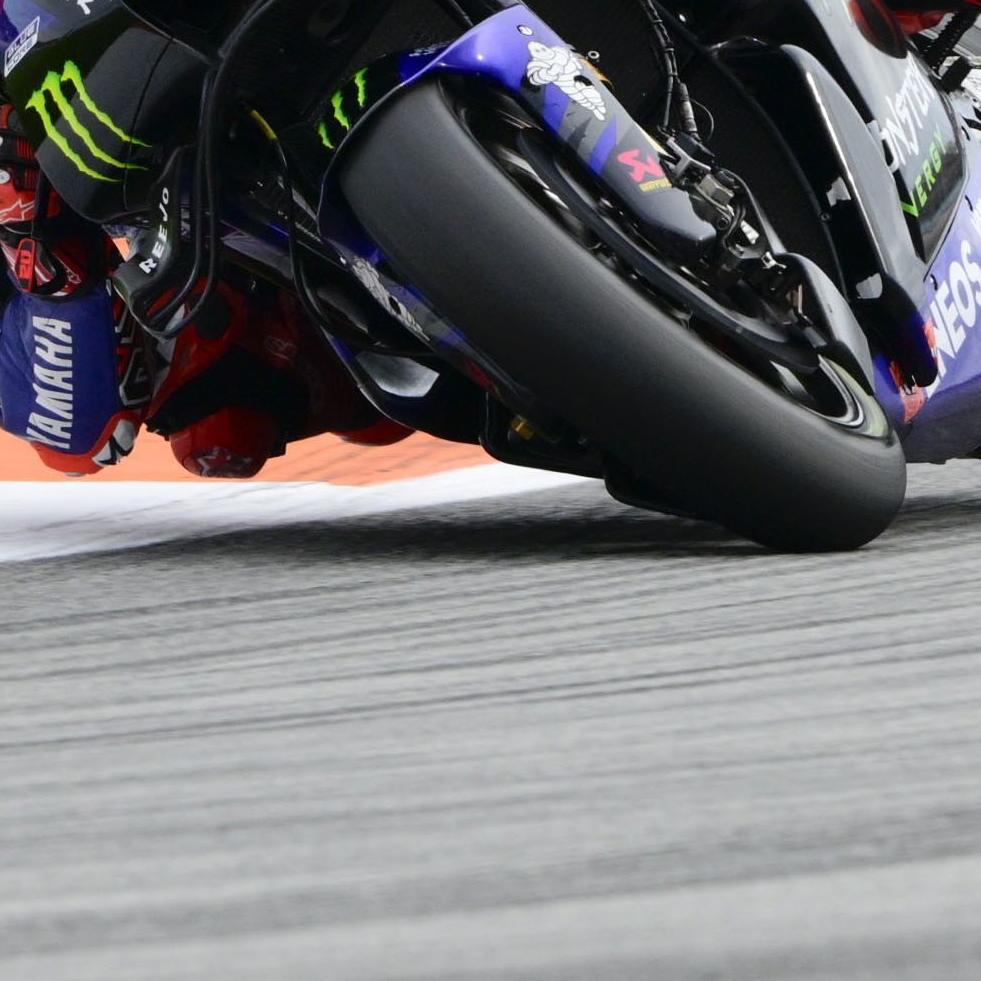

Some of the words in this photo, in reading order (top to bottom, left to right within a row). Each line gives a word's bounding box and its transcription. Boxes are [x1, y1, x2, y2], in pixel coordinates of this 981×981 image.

[901, 123, 947, 217] NERGY
[139, 187, 170, 274] REEVO
[27, 315, 73, 449] YAMAHA
